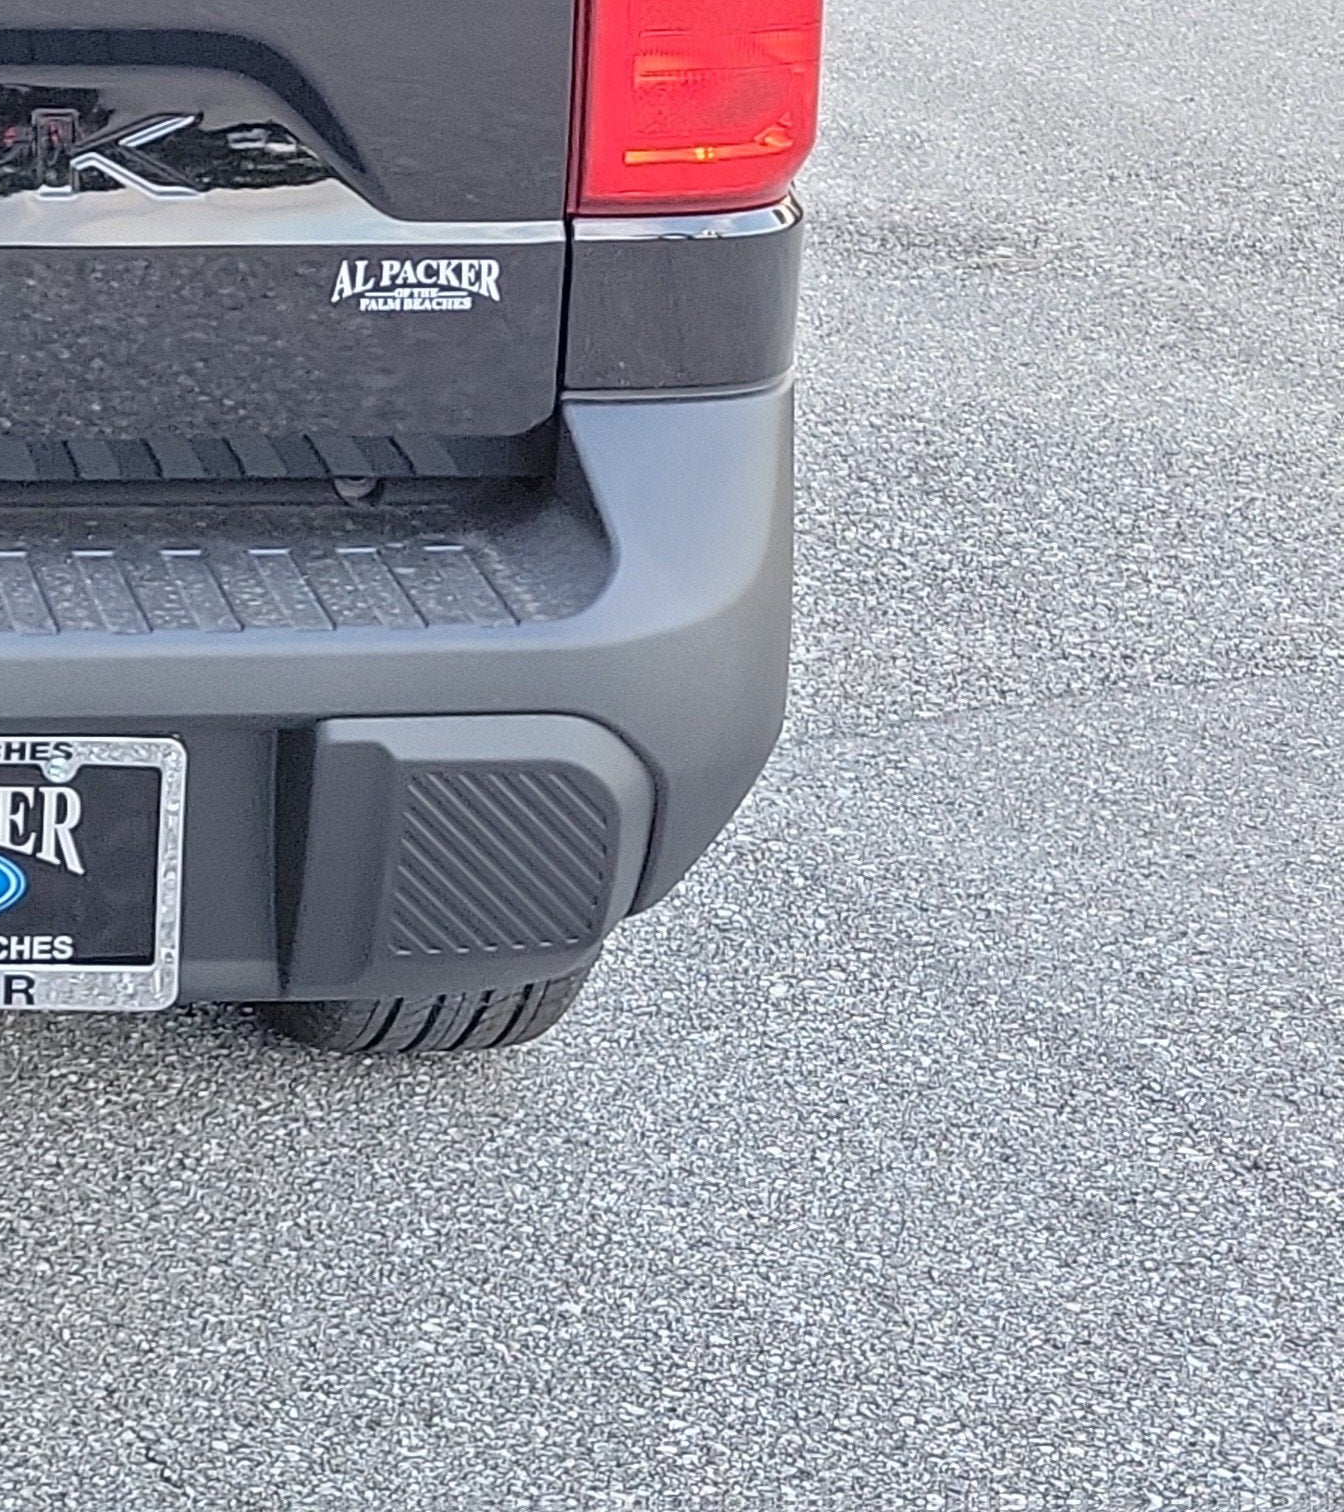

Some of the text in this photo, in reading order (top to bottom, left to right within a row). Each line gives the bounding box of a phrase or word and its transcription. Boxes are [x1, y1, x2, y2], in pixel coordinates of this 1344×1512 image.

[330, 258, 501, 303] AL PACKER
[359, 297, 472, 311] PALM BEACHES
